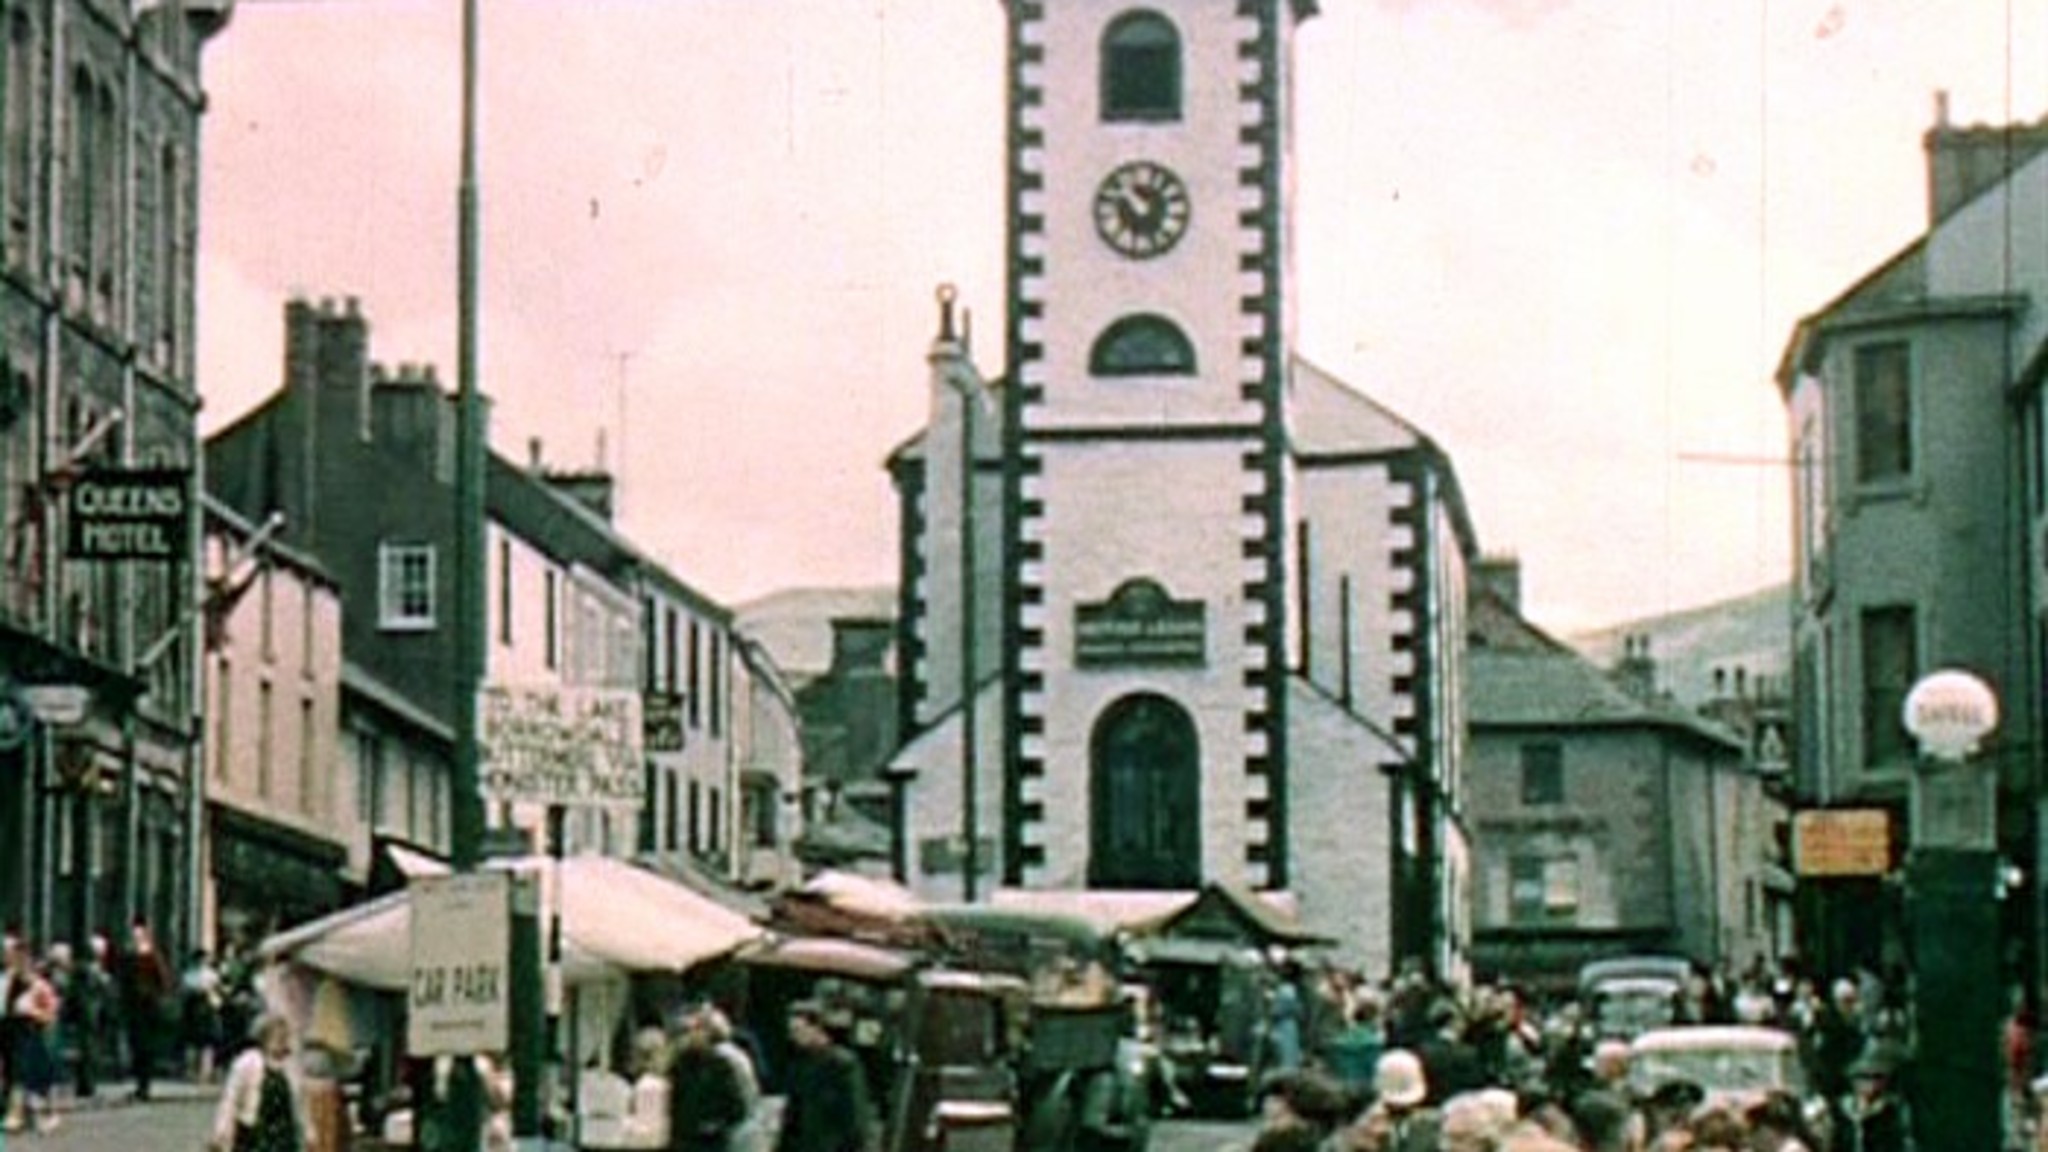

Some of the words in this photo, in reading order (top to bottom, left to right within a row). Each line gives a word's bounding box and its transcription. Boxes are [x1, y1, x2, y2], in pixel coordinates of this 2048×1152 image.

[75, 481, 182, 516] QUEENS
[83, 522, 171, 554] HOTEL
[524, 690, 561, 713] THE
[577, 694, 629, 715] LAKE
[414, 966, 446, 1008] CAR
[453, 961, 500, 1004] PARK
